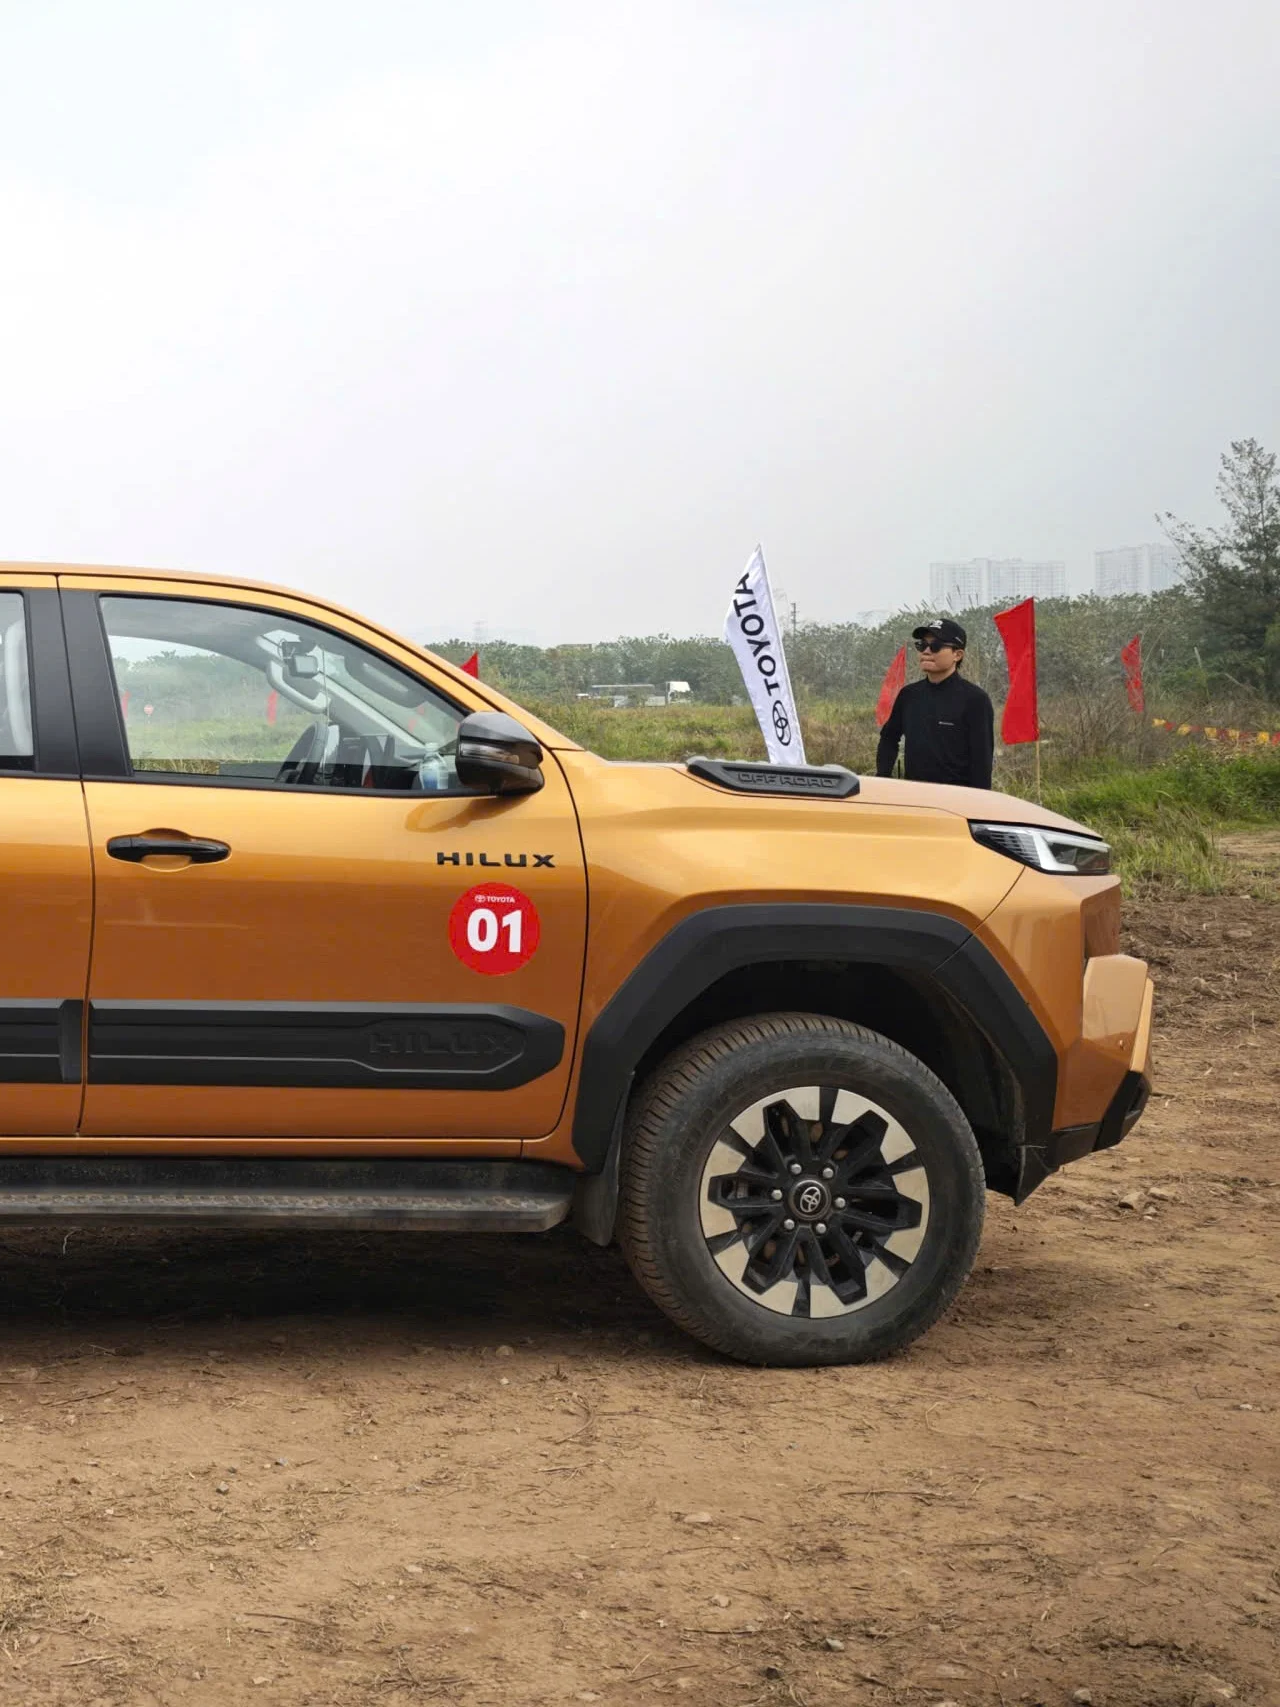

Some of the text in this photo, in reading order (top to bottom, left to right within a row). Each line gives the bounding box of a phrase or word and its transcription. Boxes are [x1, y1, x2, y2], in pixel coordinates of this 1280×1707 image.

[733, 572, 780, 697] TOYOTA
[738, 772, 837, 789] OFF ROAD
[436, 852, 556, 868] HILUX
[487, 895, 516, 904] TOYOTA
[467, 908, 523, 953] 01
[368, 1032, 514, 1055] HILUX
